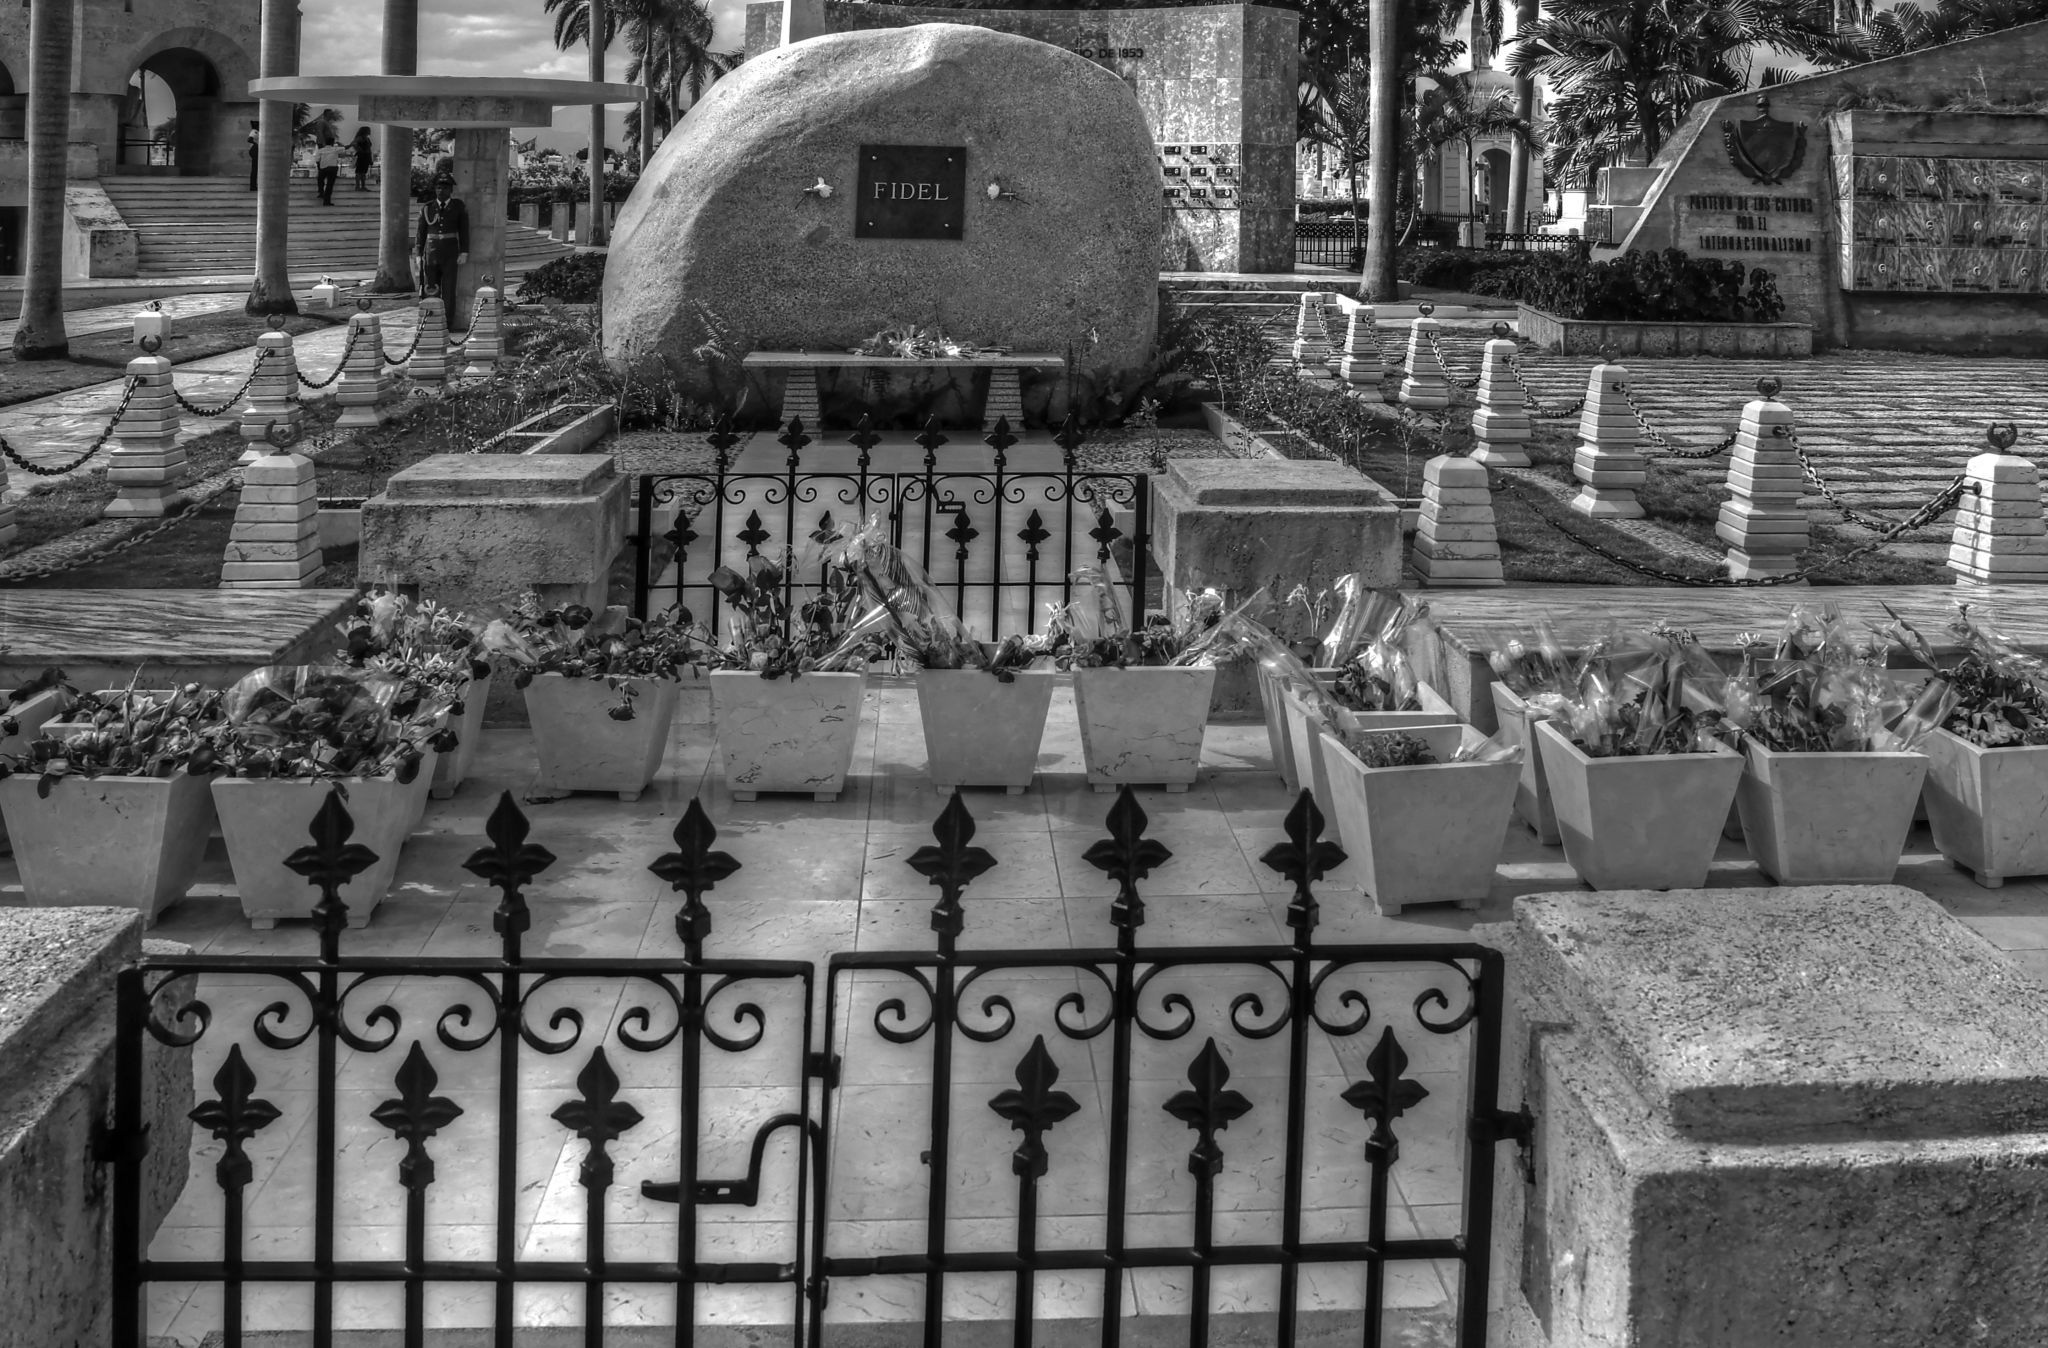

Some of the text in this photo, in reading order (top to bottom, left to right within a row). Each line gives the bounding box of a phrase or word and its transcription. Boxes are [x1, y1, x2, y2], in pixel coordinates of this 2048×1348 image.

[1098, 49, 1115, 59] DE
[873, 182, 949, 201] FIDEL
[1736, 216, 1767, 231] POR EL
